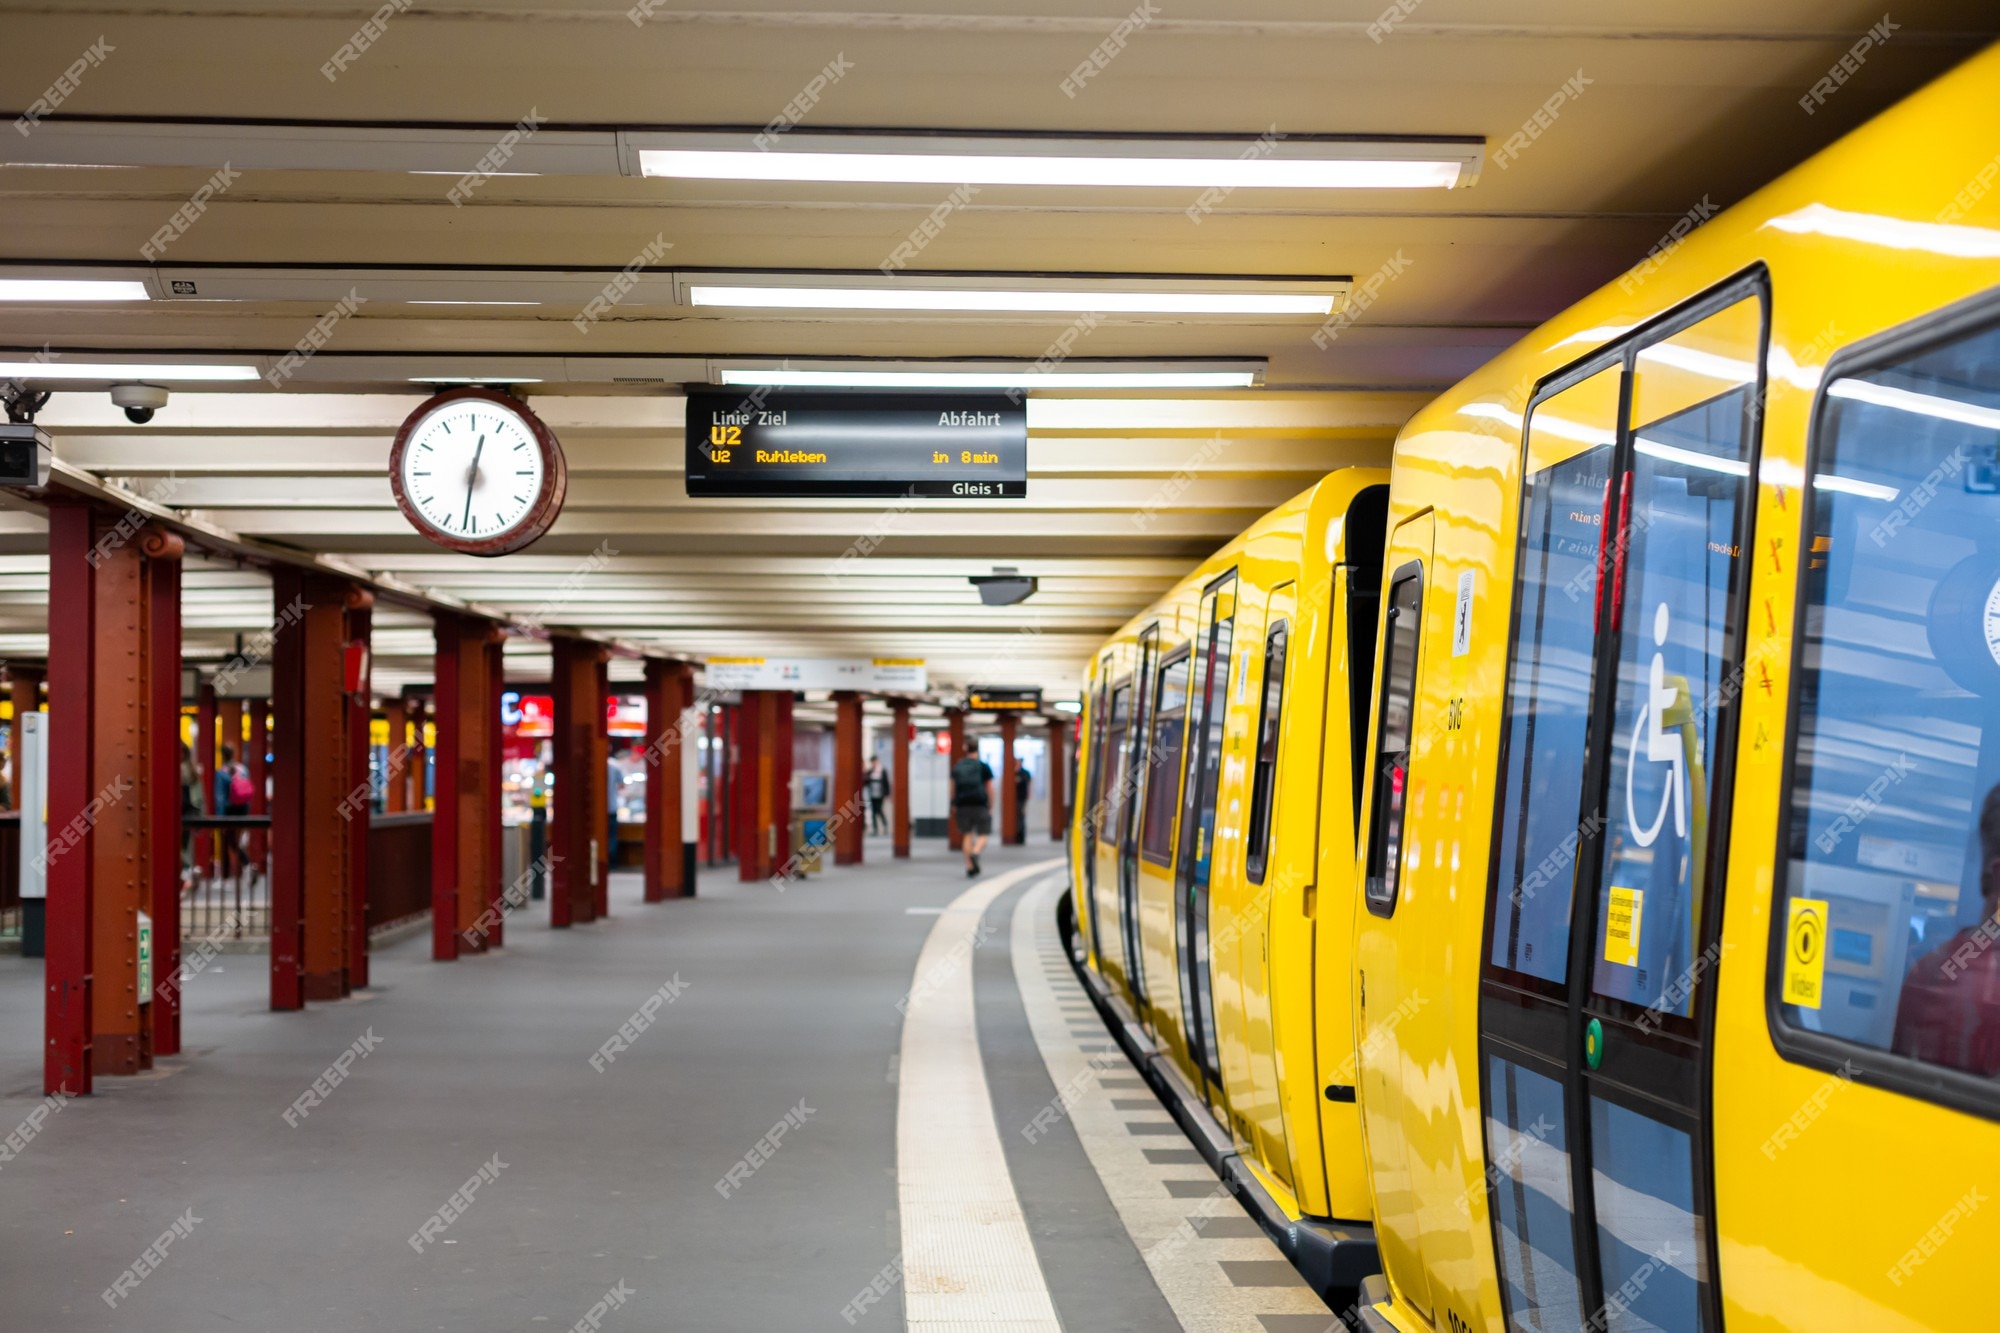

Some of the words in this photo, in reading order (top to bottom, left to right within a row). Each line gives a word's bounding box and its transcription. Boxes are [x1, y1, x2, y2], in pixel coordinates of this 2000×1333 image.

[712, 410, 750, 426] Linie
[758, 410, 787, 426] Ziel
[938, 411, 1000, 426] Abfahrt
[711, 426, 741, 445] U2
[711, 450, 731, 463] U2
[756, 450, 826, 463] Ruhleben
[933, 451, 949, 464] in
[961, 450, 972, 464] 8
[973, 452, 998, 464] min
[952, 482, 992, 495] Gleis
[996, 484, 1004, 494] 1
[1449, 698, 1462, 730] BVG
